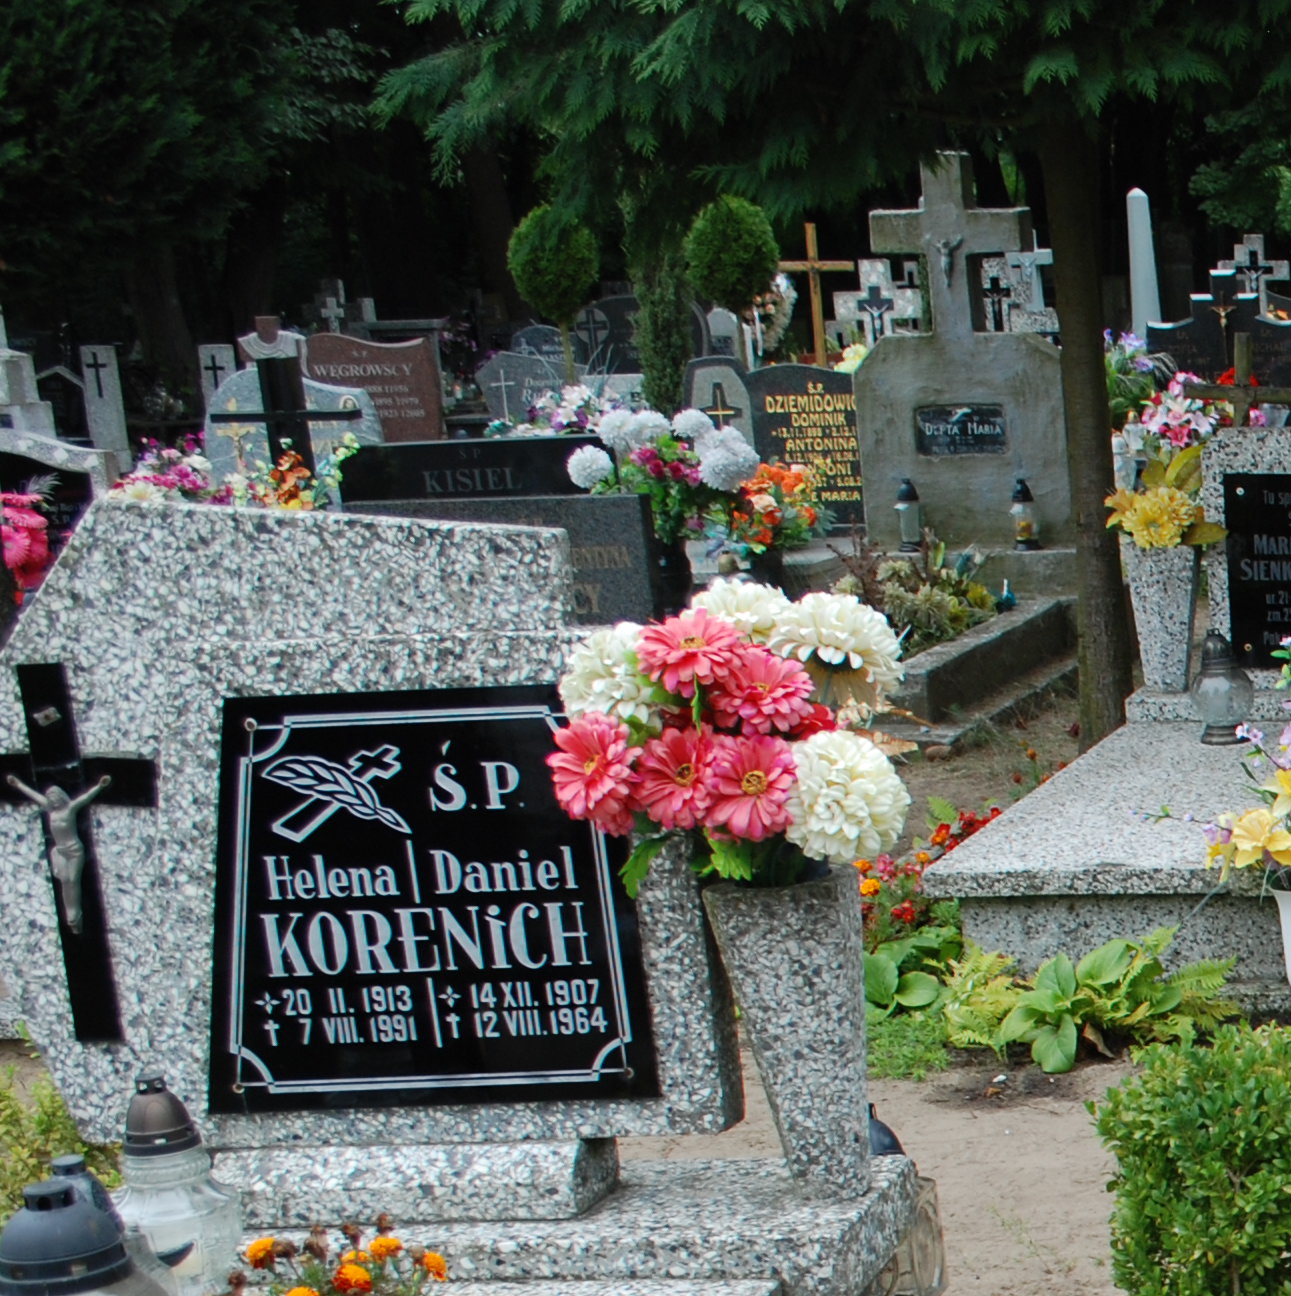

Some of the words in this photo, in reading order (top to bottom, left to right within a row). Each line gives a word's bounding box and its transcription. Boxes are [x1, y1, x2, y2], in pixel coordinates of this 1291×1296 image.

[791, 412, 847, 427] DOMINIK
[786, 437, 858, 451] ANTONINA
[422, 467, 523, 494] KISIEL
[1263, 490, 1276, 505] Tu
[263, 855, 400, 900] Helena
[428, 845, 579, 896] Daniel
[281, 989, 312, 1017] 20
[363, 985, 413, 1014] 1913
[469, 982, 497, 1010] 14
[545, 978, 600, 1006] 1907
[300, 1018, 312, 1045] 7
[370, 1014, 418, 1043] 1991
[475, 1011, 501, 1038] 12
[548, 1007, 608, 1035] 1964
